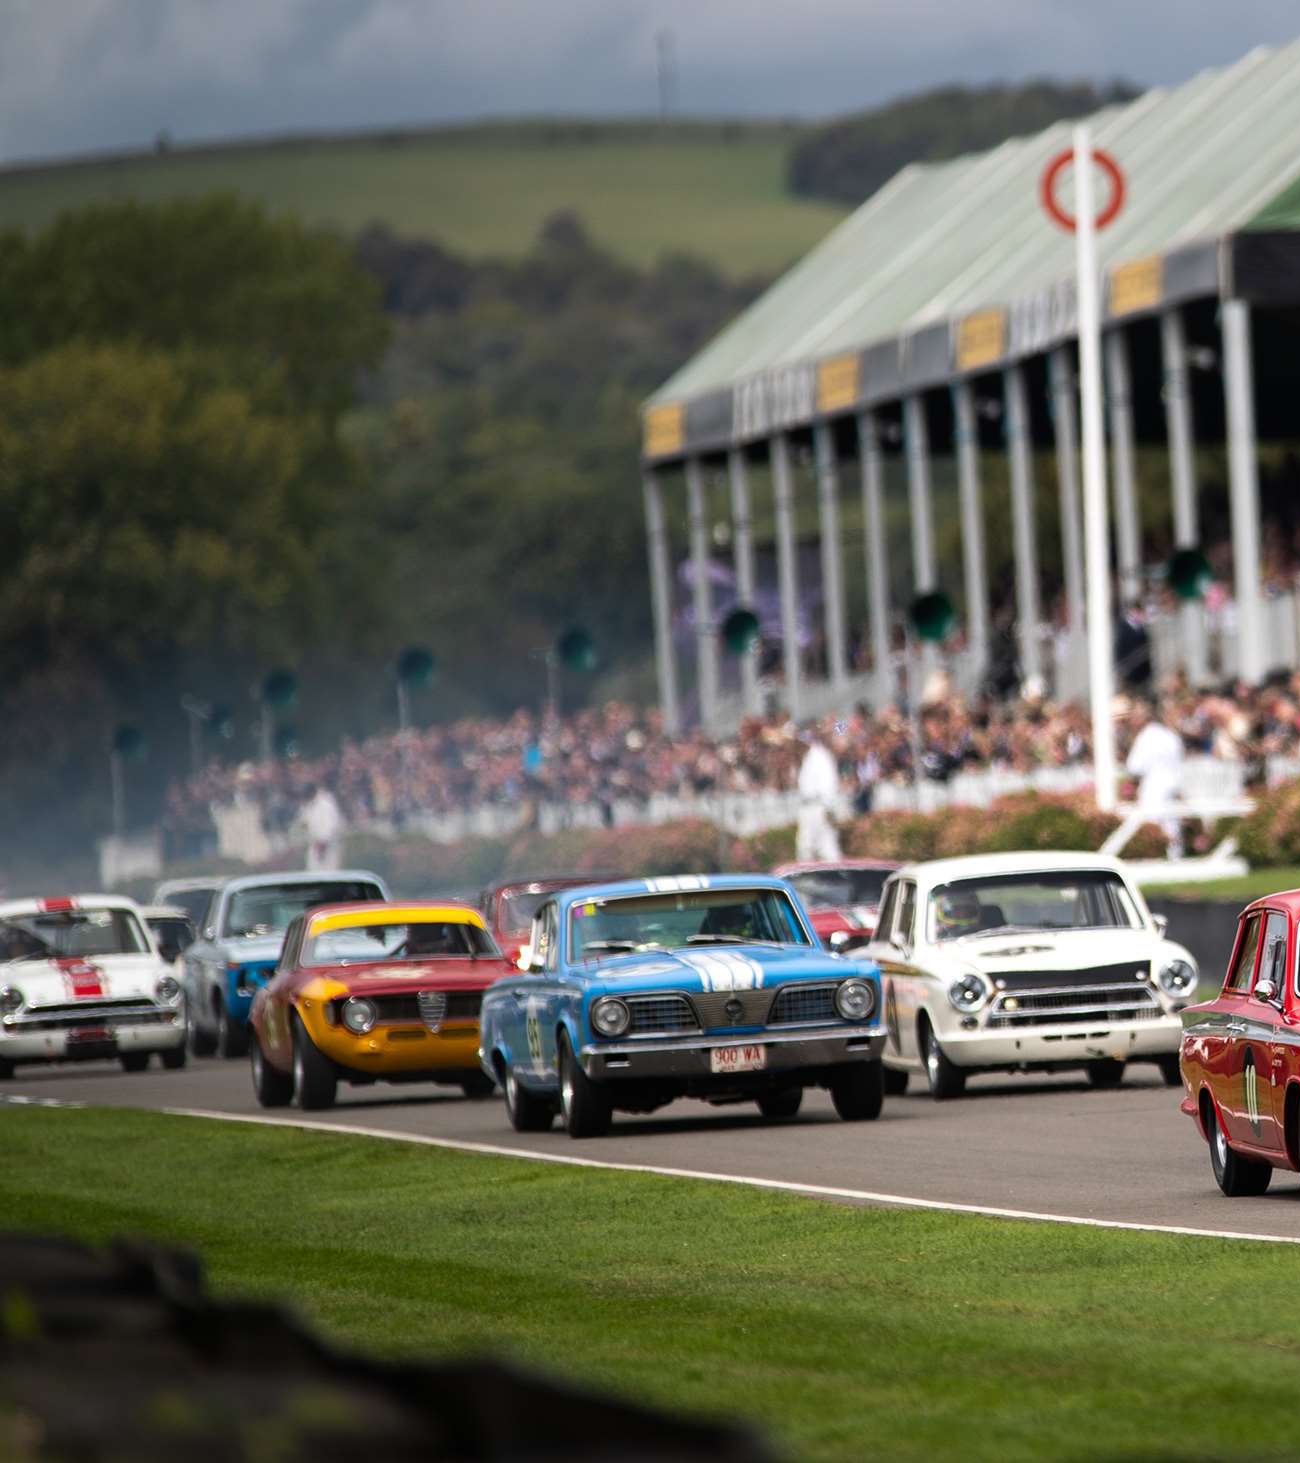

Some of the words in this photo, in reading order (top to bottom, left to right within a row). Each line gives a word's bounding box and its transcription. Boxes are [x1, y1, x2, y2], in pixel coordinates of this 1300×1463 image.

[714, 1047, 738, 1065] 900
[743, 1045, 761, 1061] WA
[1245, 1064, 1259, 1124] 10
